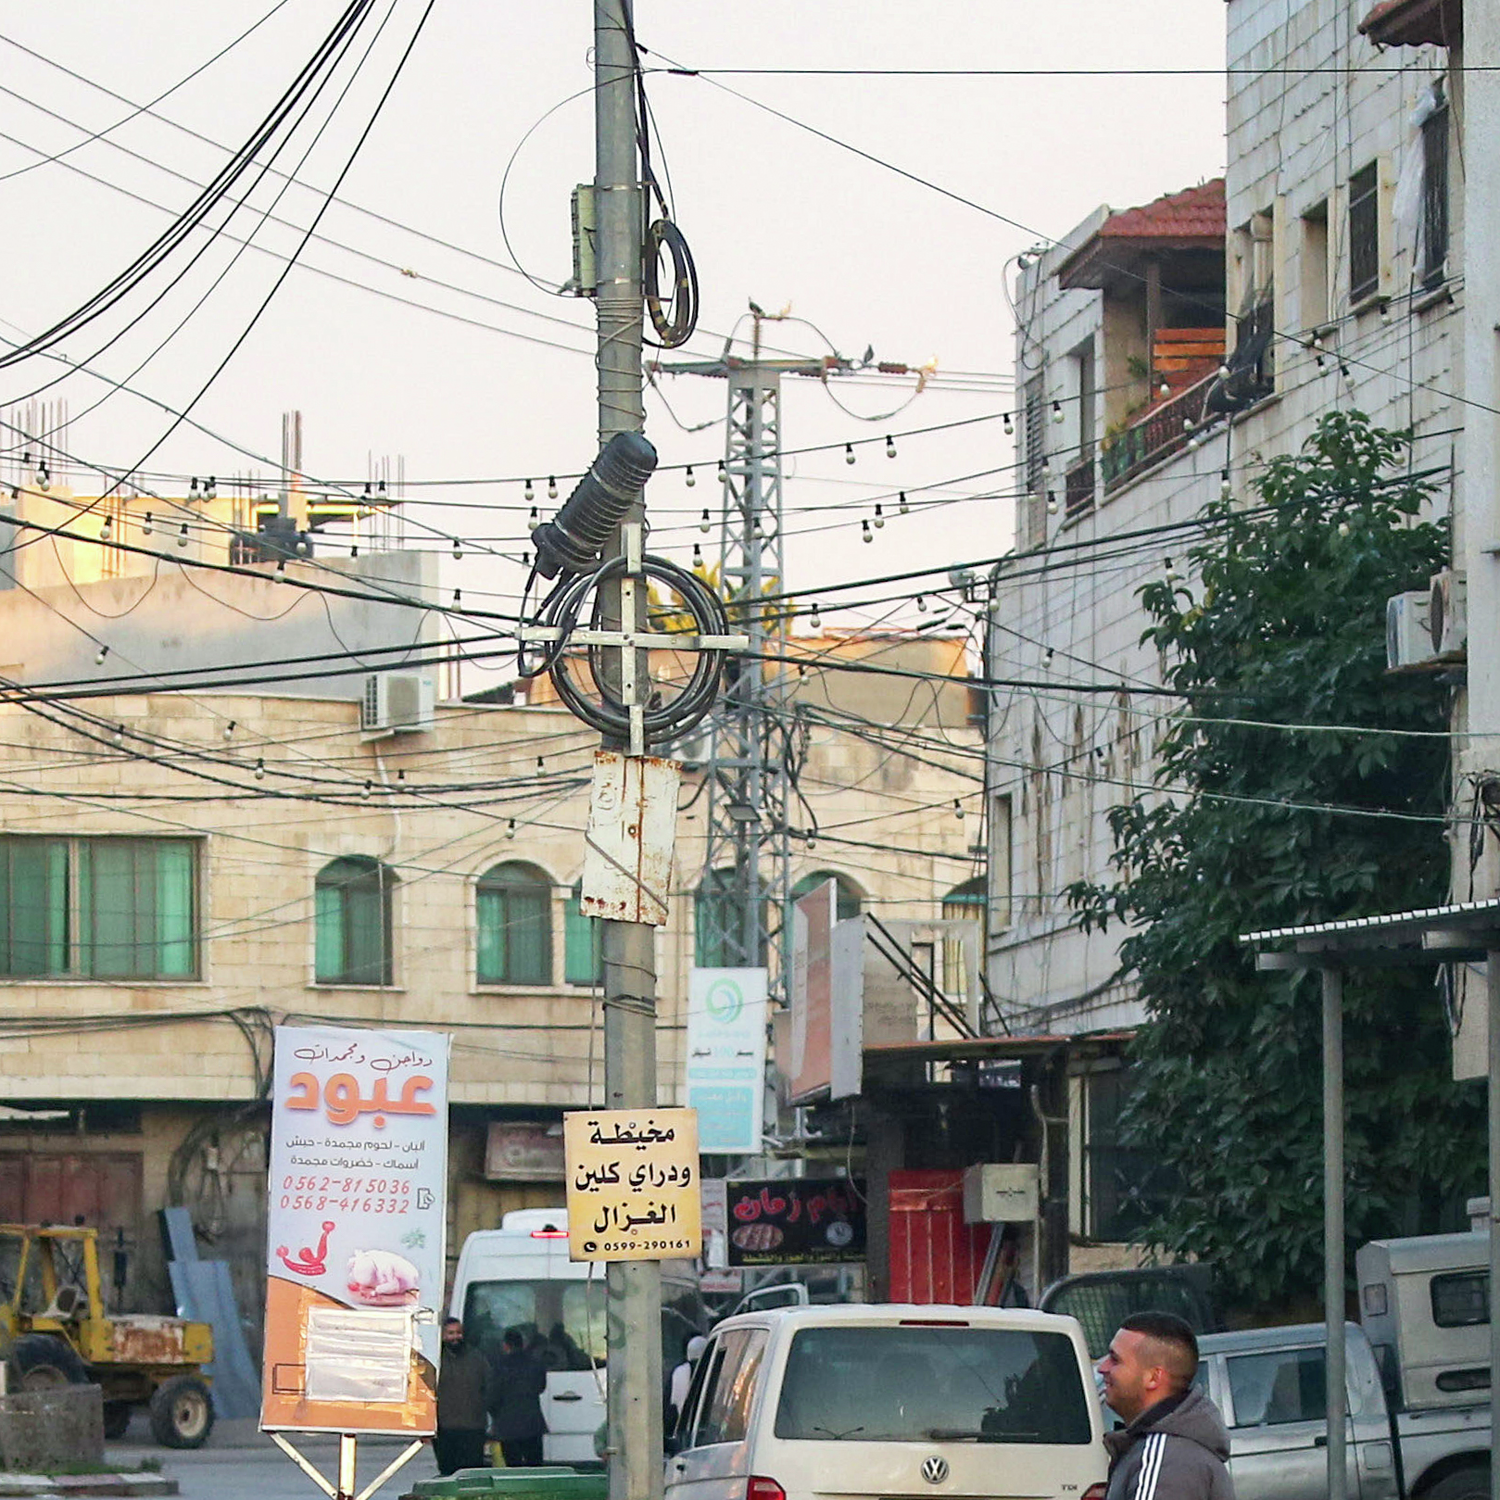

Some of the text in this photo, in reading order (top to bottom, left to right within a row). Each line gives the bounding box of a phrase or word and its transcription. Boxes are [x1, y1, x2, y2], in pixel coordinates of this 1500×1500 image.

[370, 1051, 432, 1074] دواجن
[285, 1072, 437, 1129] عبود
[286, 1135, 315, 1149] حبش
[324, 1138, 362, 1150] مجمدة
[588, 1120, 675, 1150] مخيطة
[364, 1140, 393, 1151] لحوم
[290, 1155, 328, 1166] مجمدة
[330, 1157, 373, 1169] خضروات
[283, 1175, 410, 1194] 0562-815036
[575, 1161, 691, 1193] ودراي كلين
[280, 1194, 409, 1213] 0568-416332
[733, 1187, 802, 1223] زمان
[594, 1202, 676, 1233] الغزال
[604, 1239, 690, 1252] 0599-290161
